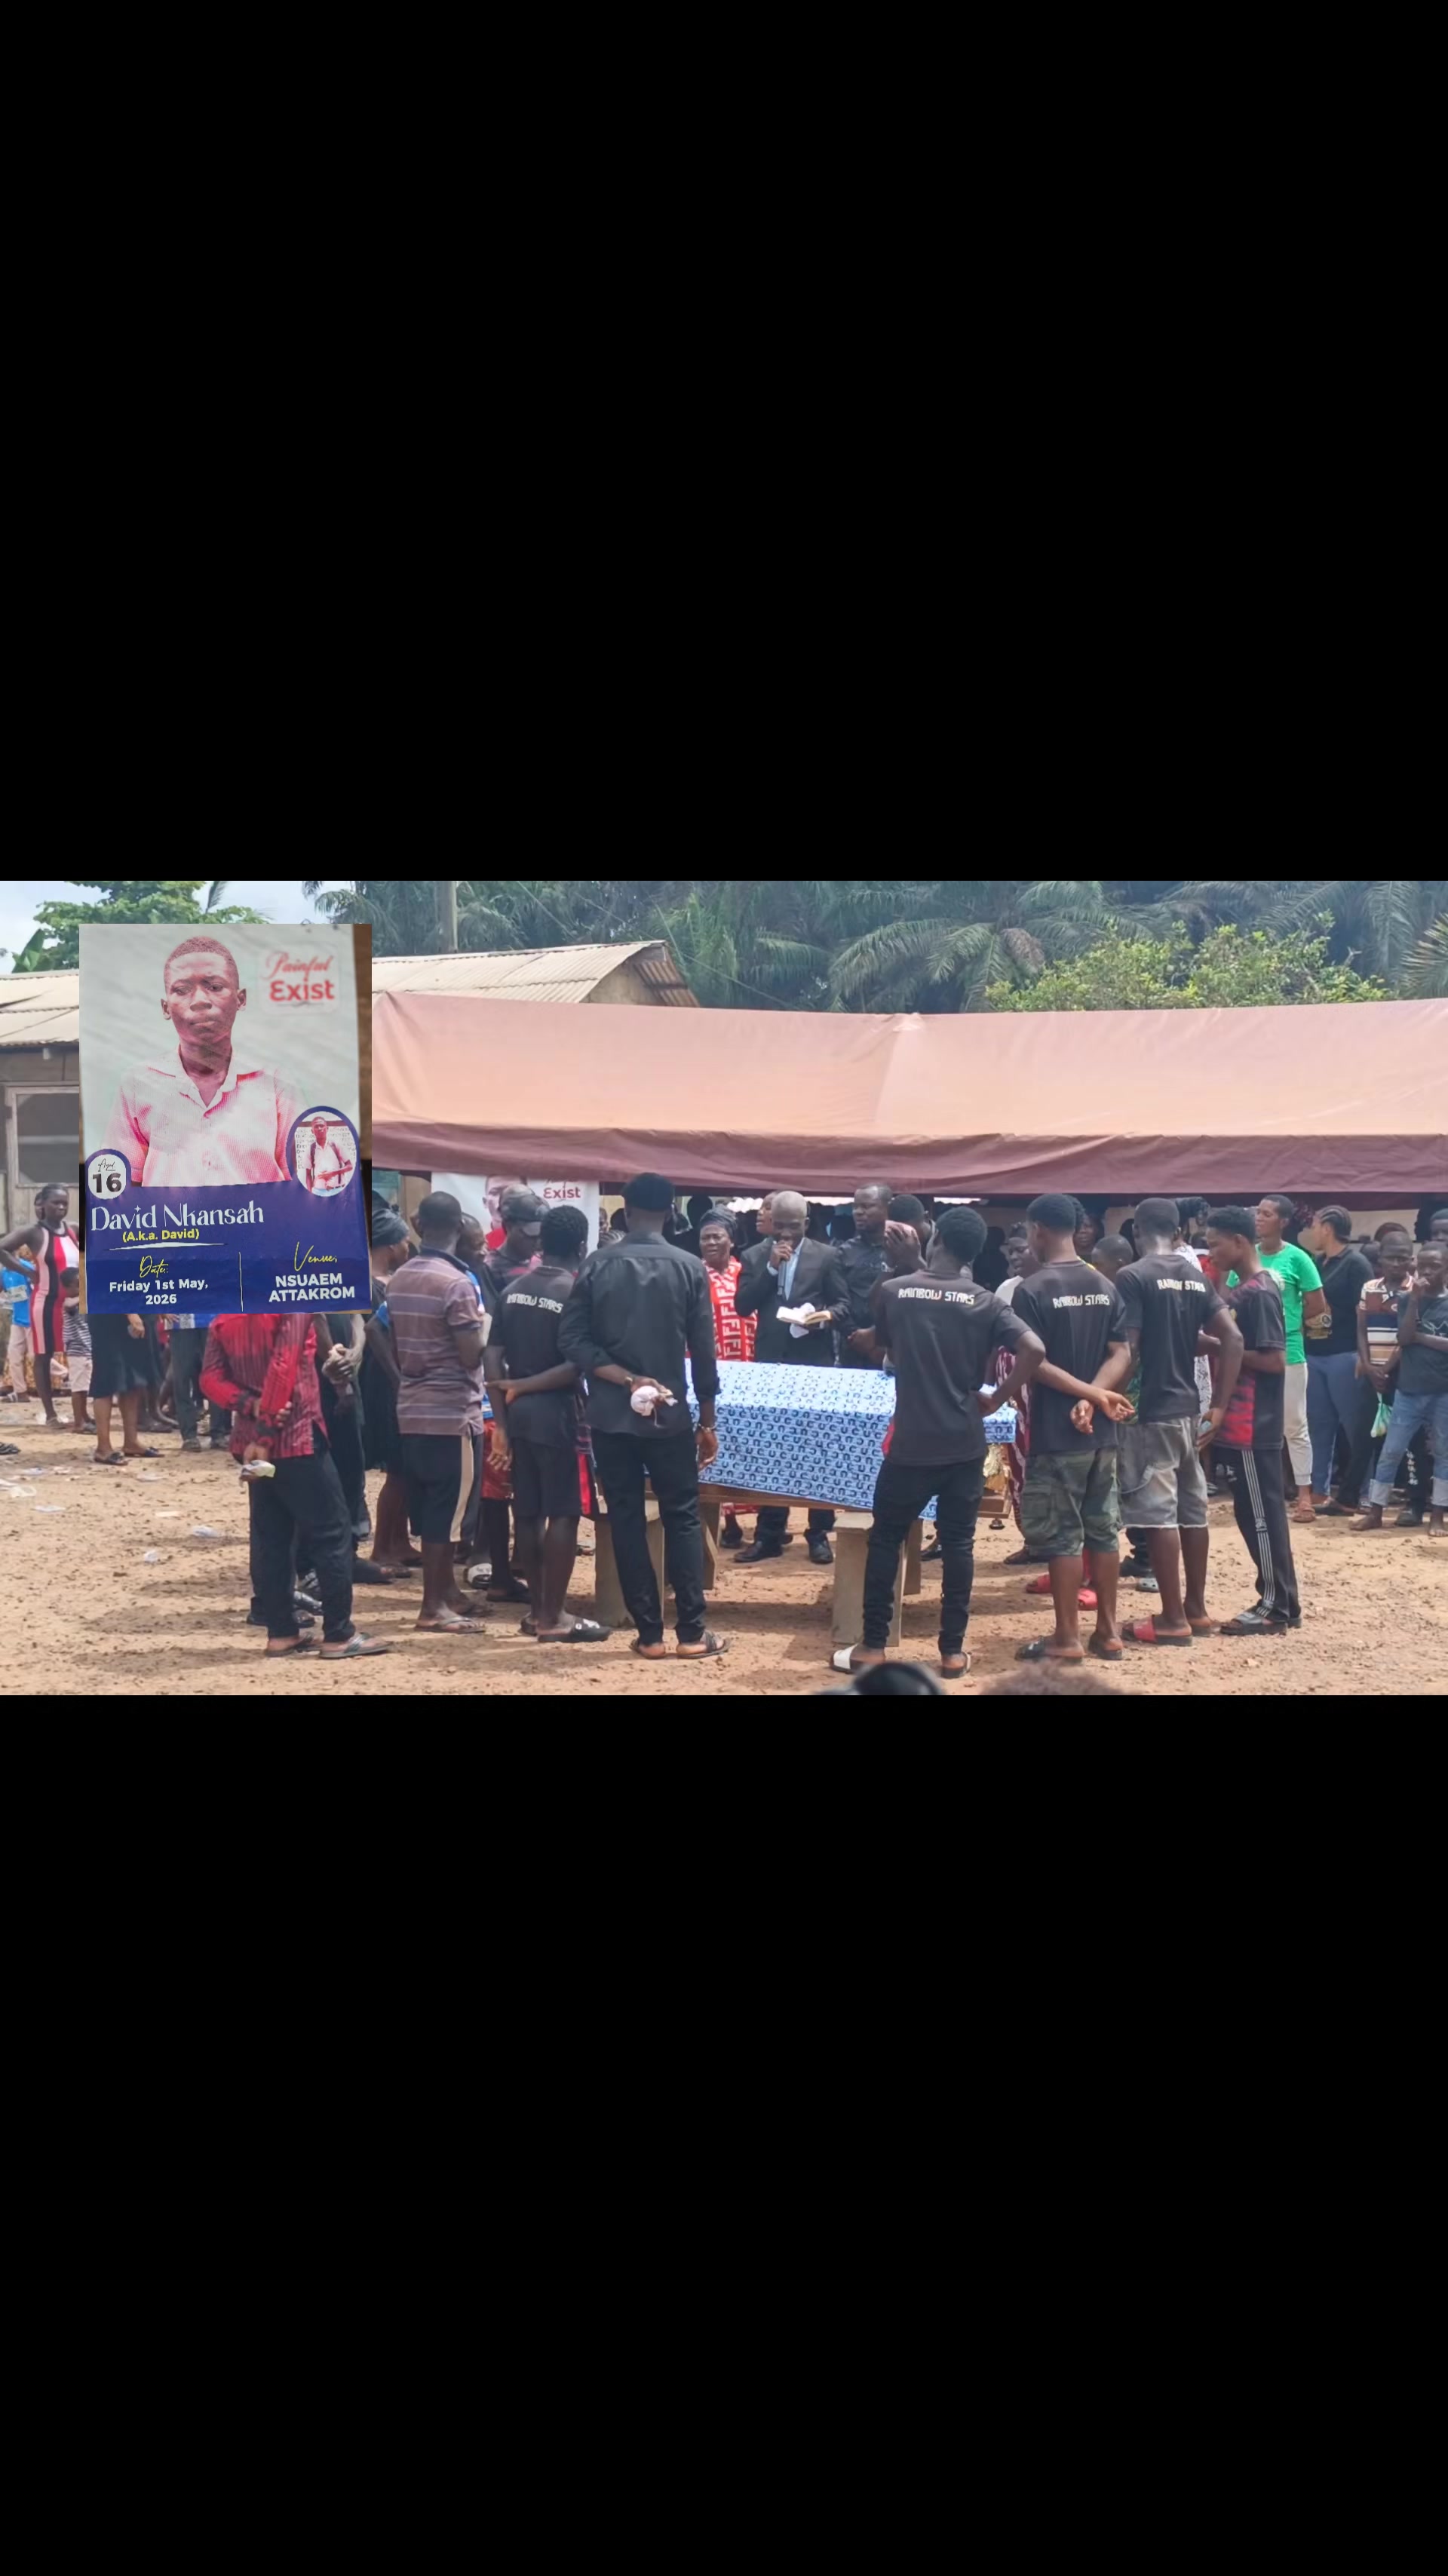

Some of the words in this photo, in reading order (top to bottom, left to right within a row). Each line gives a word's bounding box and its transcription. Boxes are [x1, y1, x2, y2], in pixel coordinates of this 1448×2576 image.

[261, 950, 333, 981] Painful
[269, 979, 335, 1001] Exist
[92, 1173, 122, 1193] 16
[543, 1186, 581, 1199] Exist
[91, 1204, 157, 1231] David
[164, 1200, 264, 1227] Nkansah
[122, 1230, 158, 1243] (A.k.a.
[161, 1228, 200, 1240] David)
[109, 1280, 151, 1293] Friday
[155, 1280, 175, 1290] 1st
[178, 1278, 209, 1290] May,
[275, 1272, 342, 1287] NSUAEM
[145, 1293, 177, 1305] 2026
[268, 1286, 355, 1302] ATTAKROM
[898, 1287, 942, 1300] RAINBOW
[944, 1291, 975, 1305] STARS
[1084, 1294, 1110, 1305] STARS
